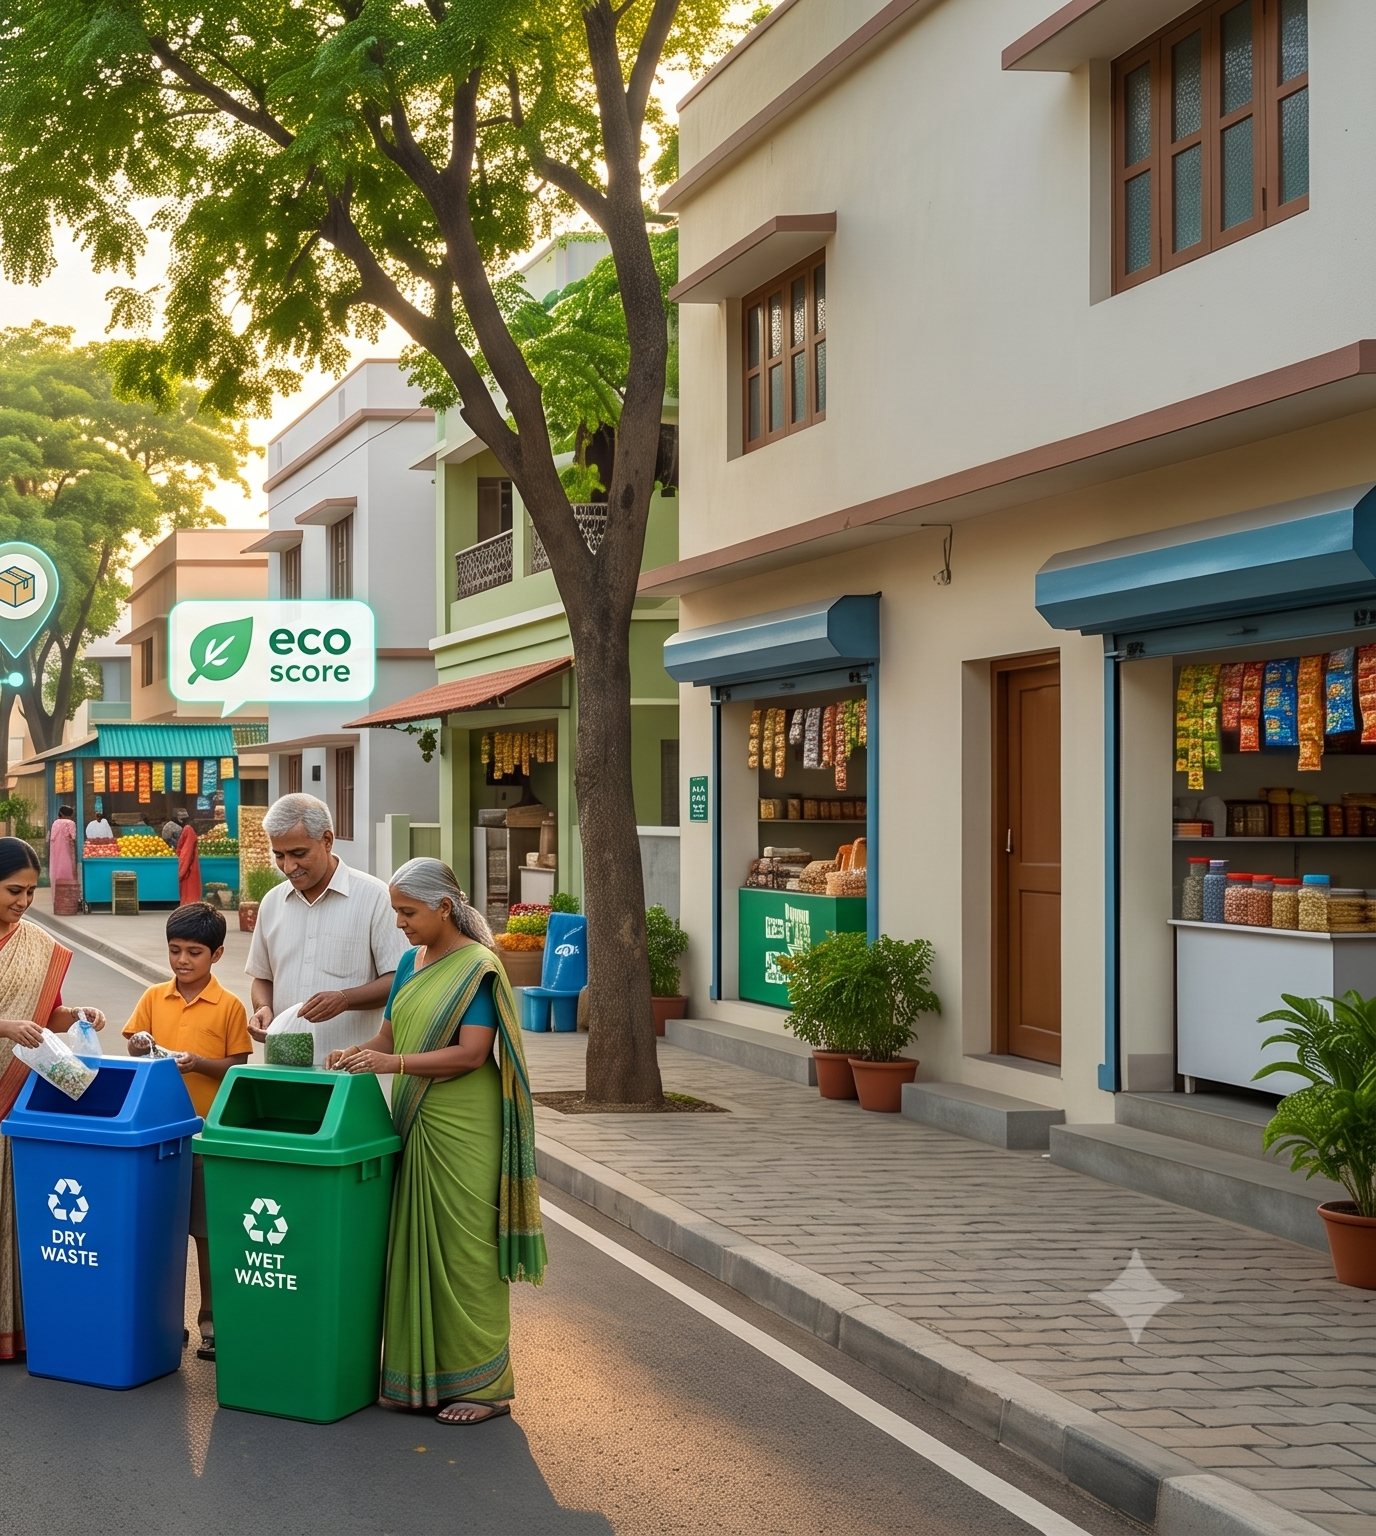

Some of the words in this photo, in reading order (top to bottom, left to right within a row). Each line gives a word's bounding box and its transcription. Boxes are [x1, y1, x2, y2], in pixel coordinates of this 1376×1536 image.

[52, 1229, 86, 1247] DRY
[40, 1245, 99, 1267] WASTE
[244, 1250, 285, 1270] WET
[234, 1268, 298, 1290] WASTE
